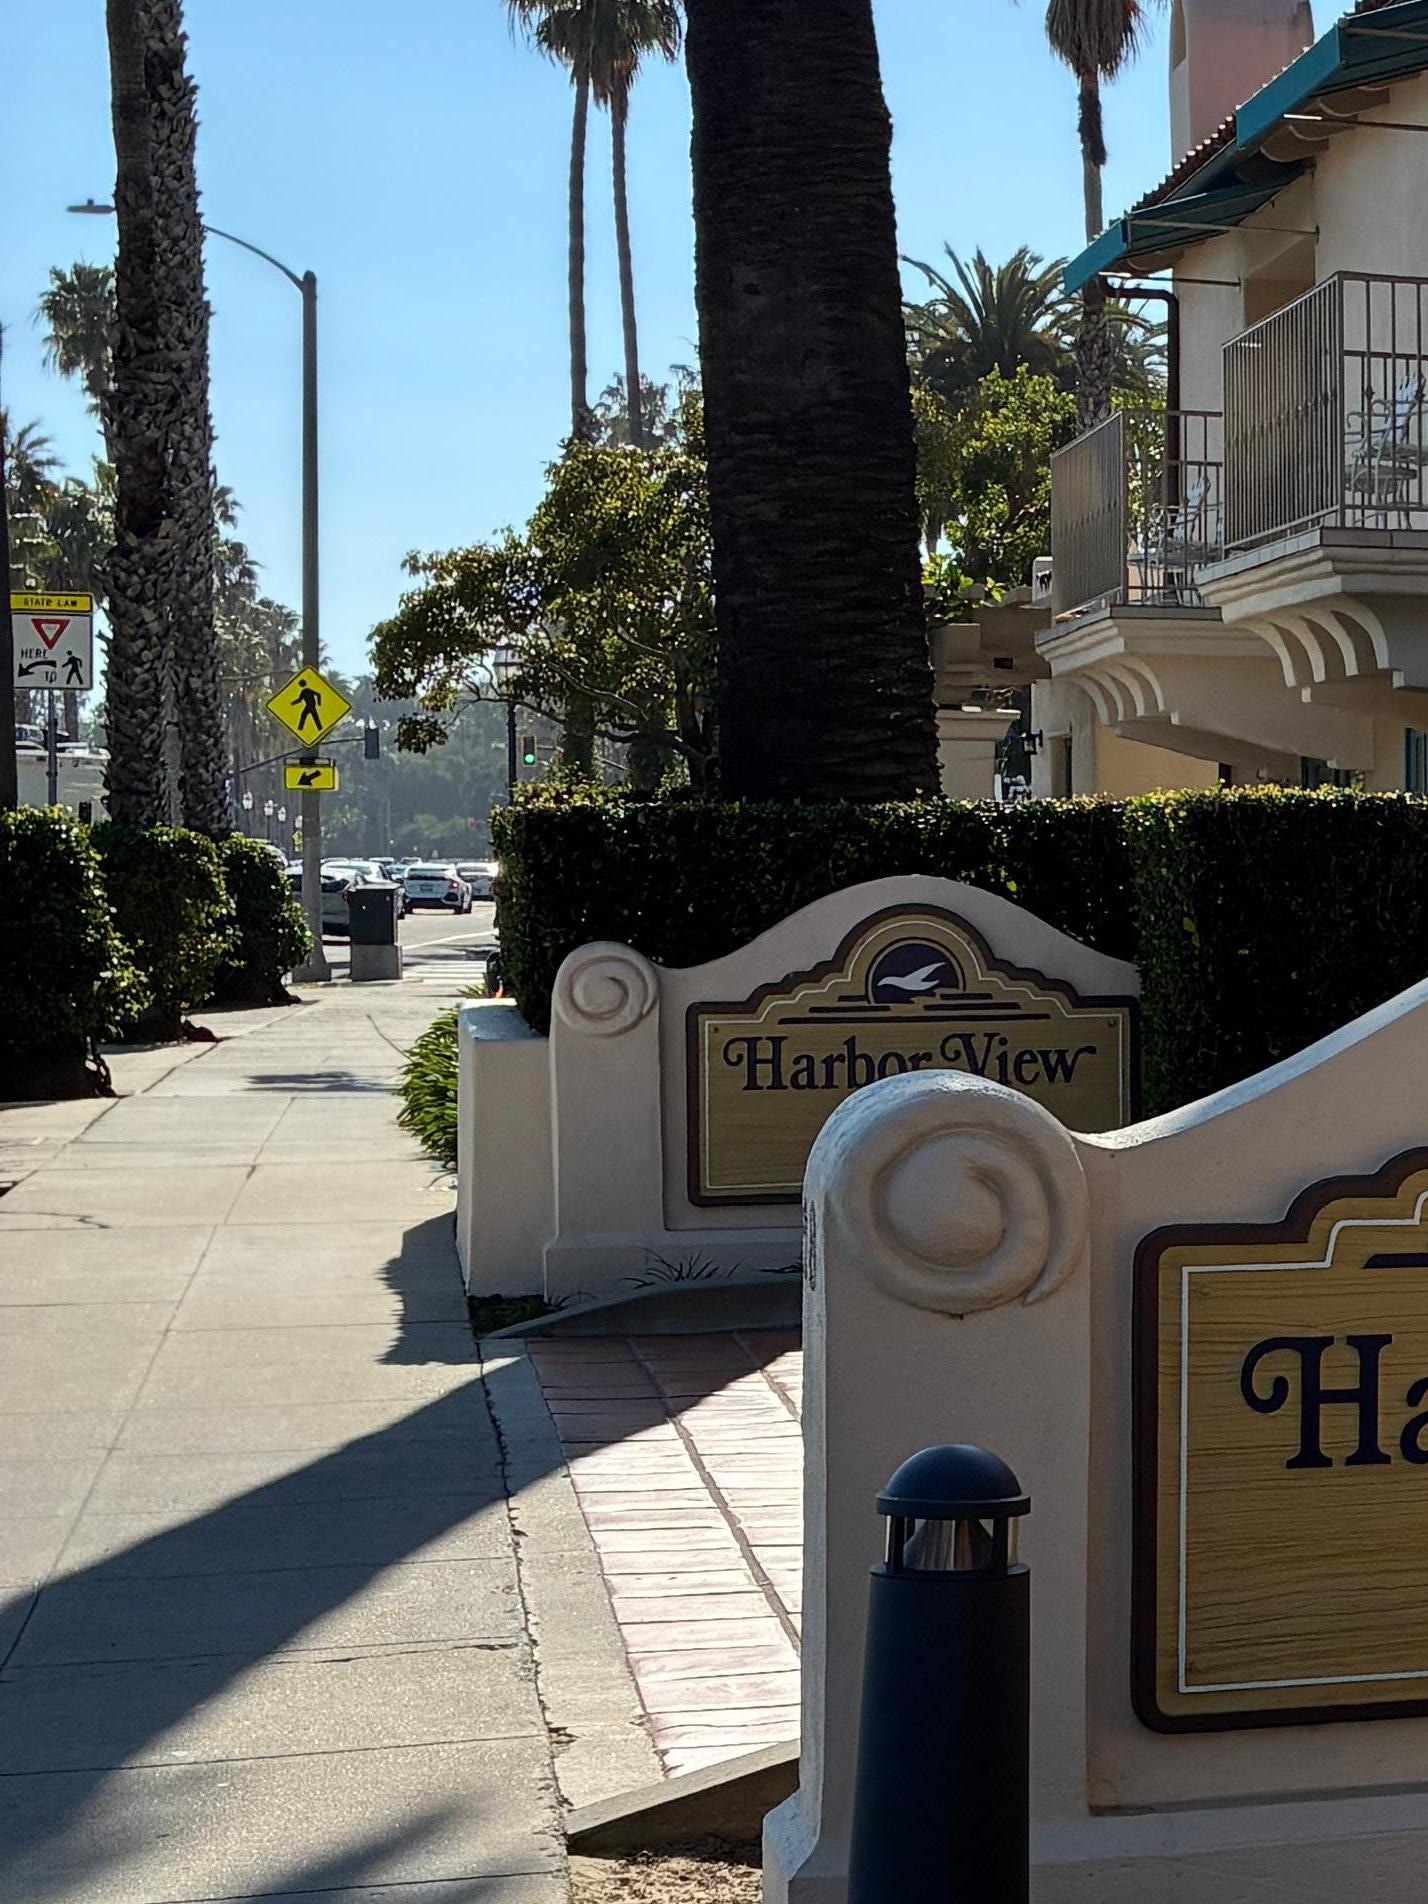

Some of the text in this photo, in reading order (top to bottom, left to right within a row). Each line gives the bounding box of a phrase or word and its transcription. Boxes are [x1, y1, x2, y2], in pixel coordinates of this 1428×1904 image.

[23, 597, 78, 607] STATE LAW
[20, 648, 48, 659] HERE
[940, 1032, 1097, 1086] View
